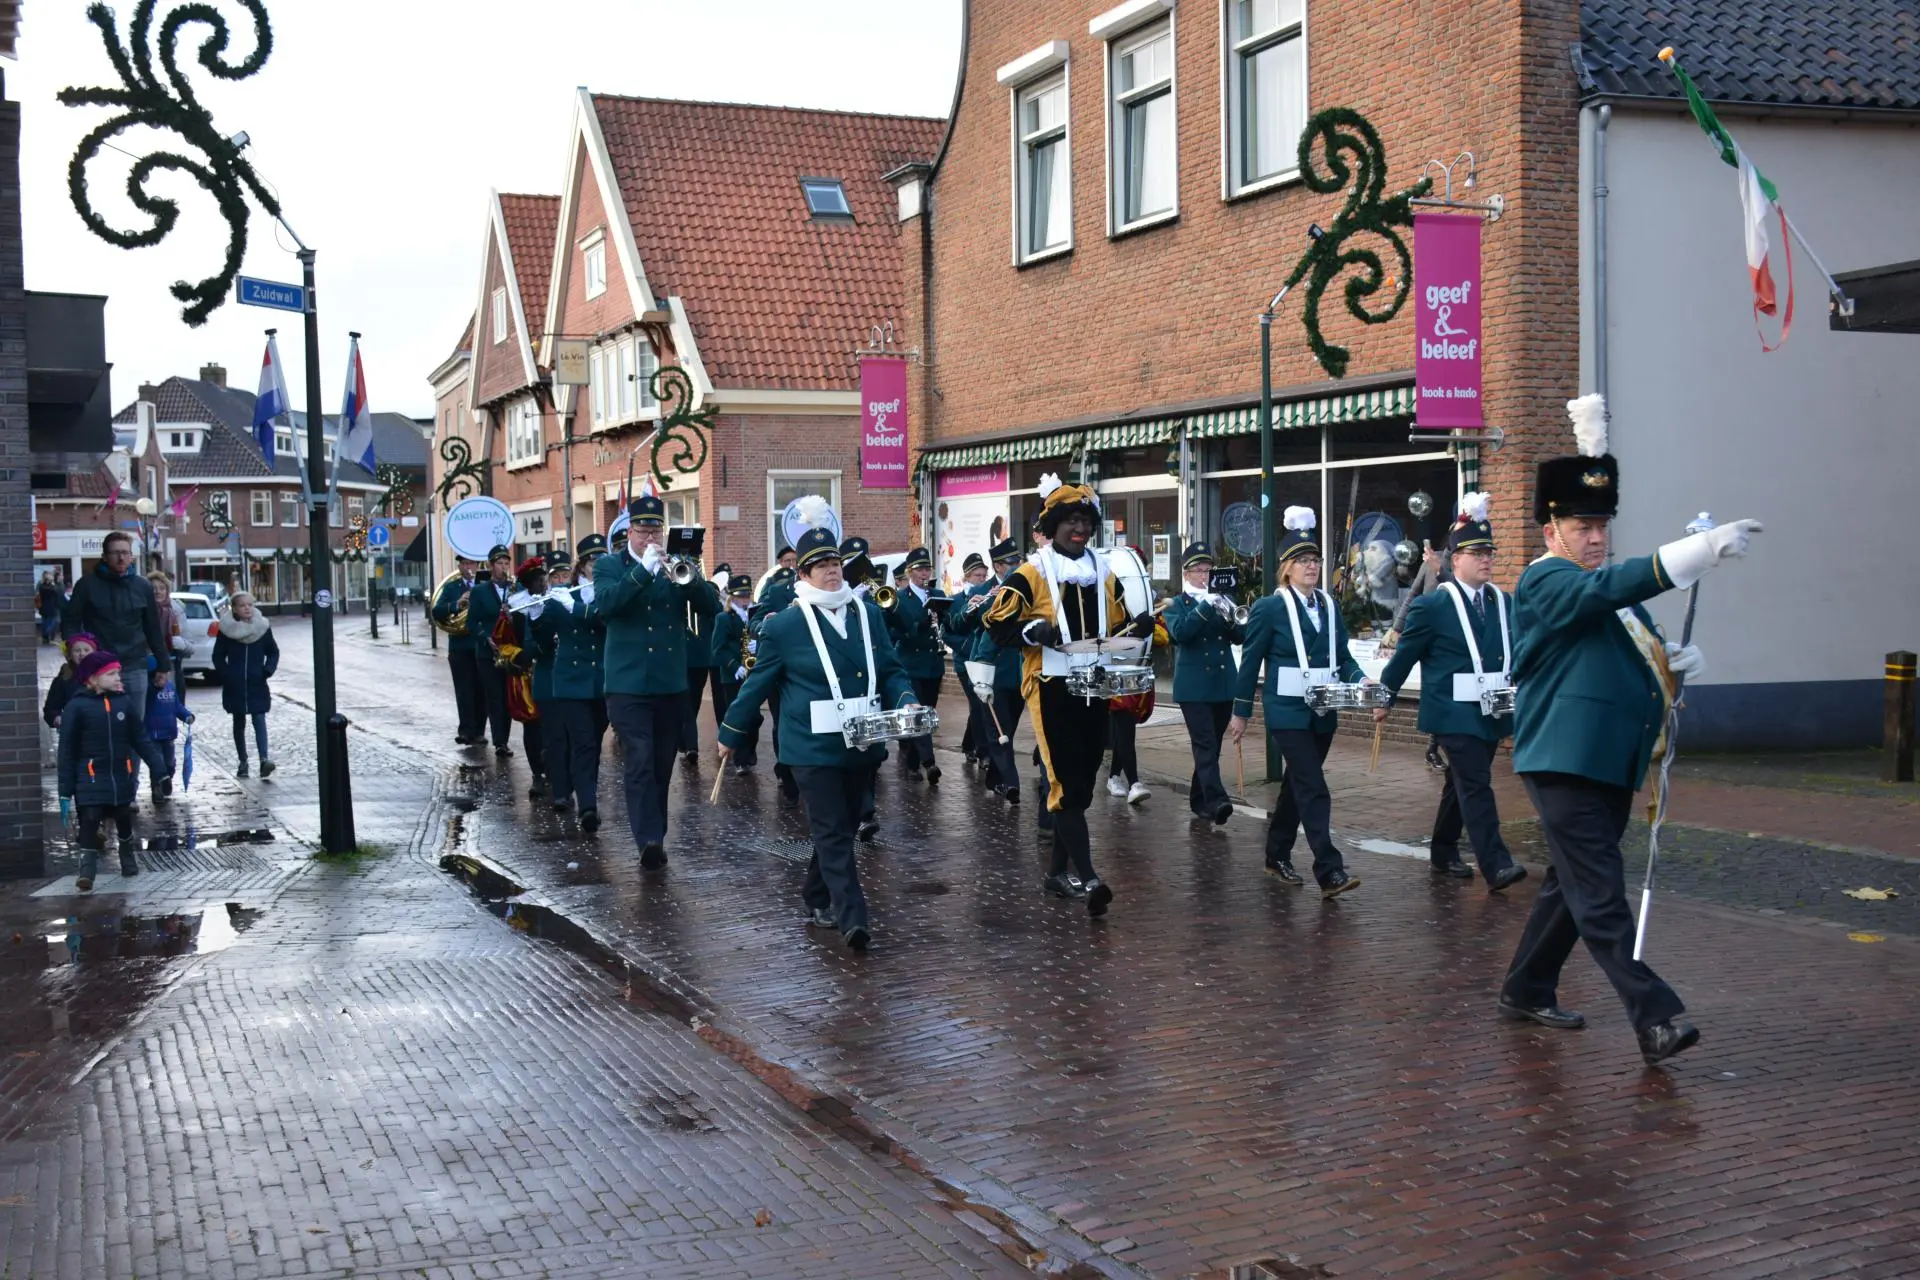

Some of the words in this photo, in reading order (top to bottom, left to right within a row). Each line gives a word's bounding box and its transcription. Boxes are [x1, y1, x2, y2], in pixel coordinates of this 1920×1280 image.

[252, 285, 293, 303] Zuidwal
[1426, 280, 1471, 310] geef
[1434, 304, 1468, 337] &
[1421, 338, 1477, 360] beleef
[1422, 386, 1444, 398] kook
[1454, 386, 1477, 398] kado
[868, 398, 900, 416] geef
[874, 413, 898, 433] &
[866, 433, 904, 447] beleef
[454, 510, 500, 521] AMICITIA
